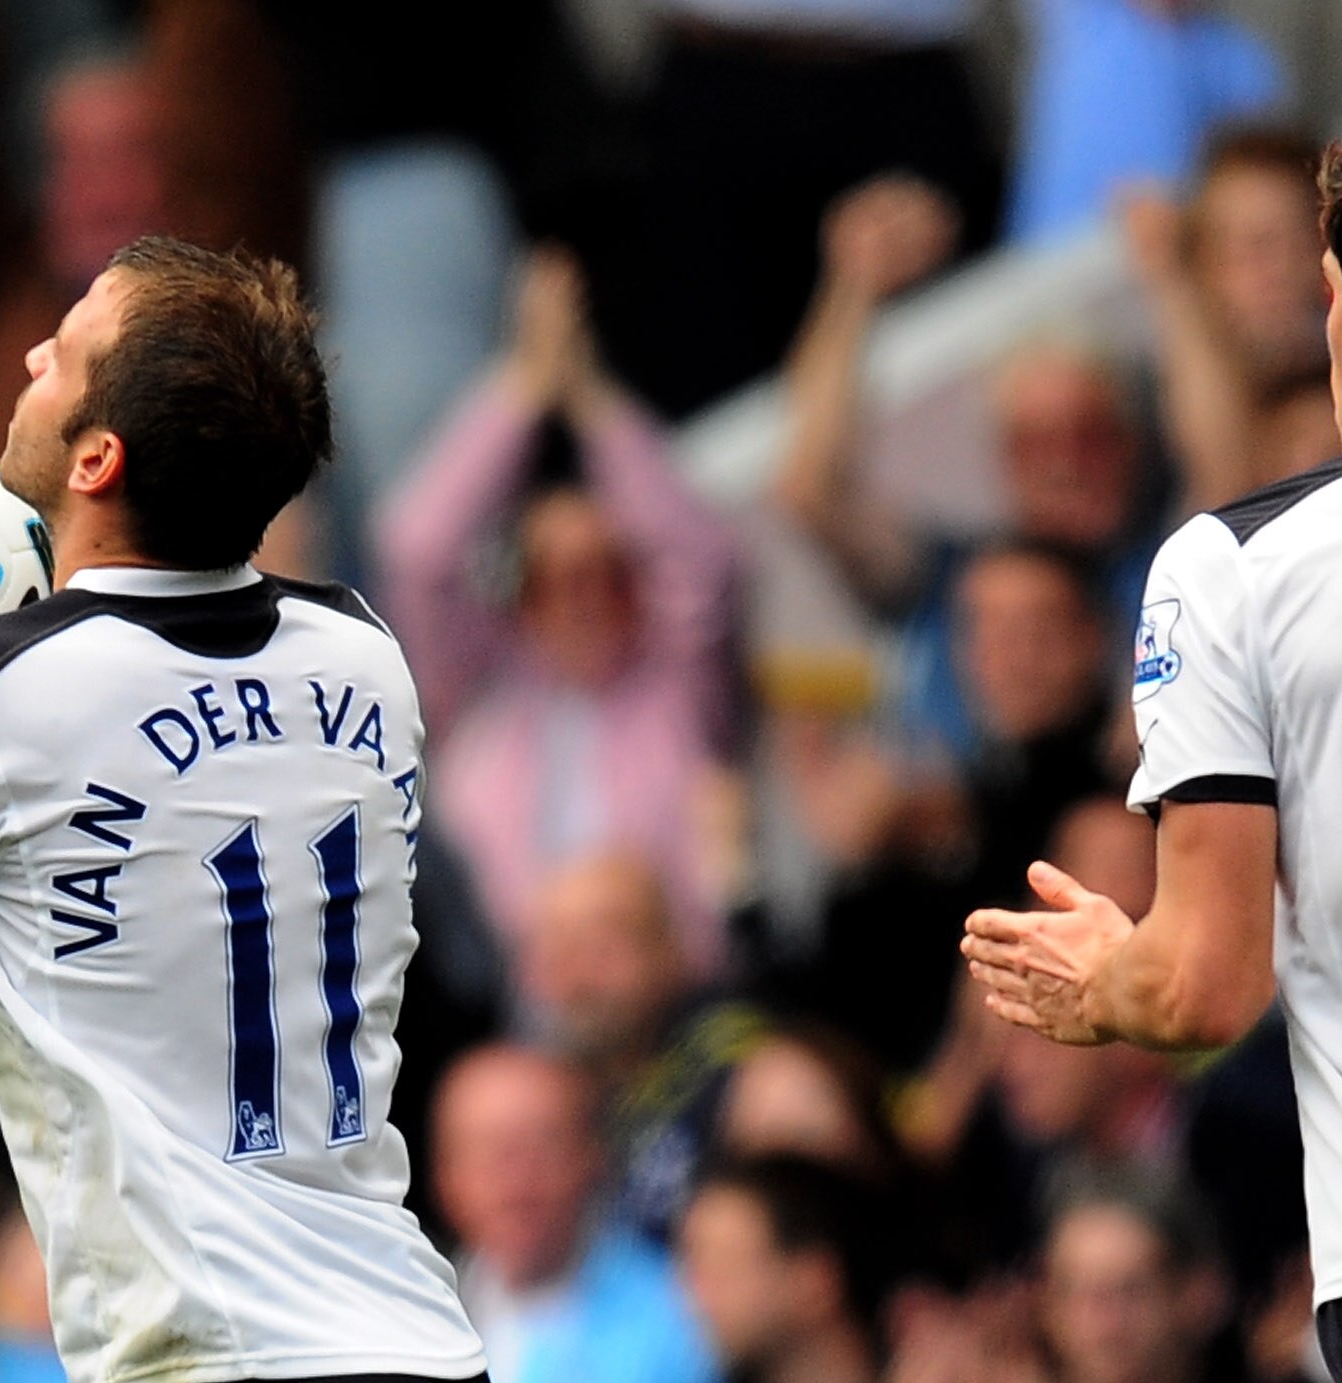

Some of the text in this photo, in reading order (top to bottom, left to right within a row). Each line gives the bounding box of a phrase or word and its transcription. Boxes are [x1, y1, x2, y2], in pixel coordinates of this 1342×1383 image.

[49, 781, 147, 961] VAN
[137, 677, 285, 776] DER
[201, 799, 368, 1163] 11
